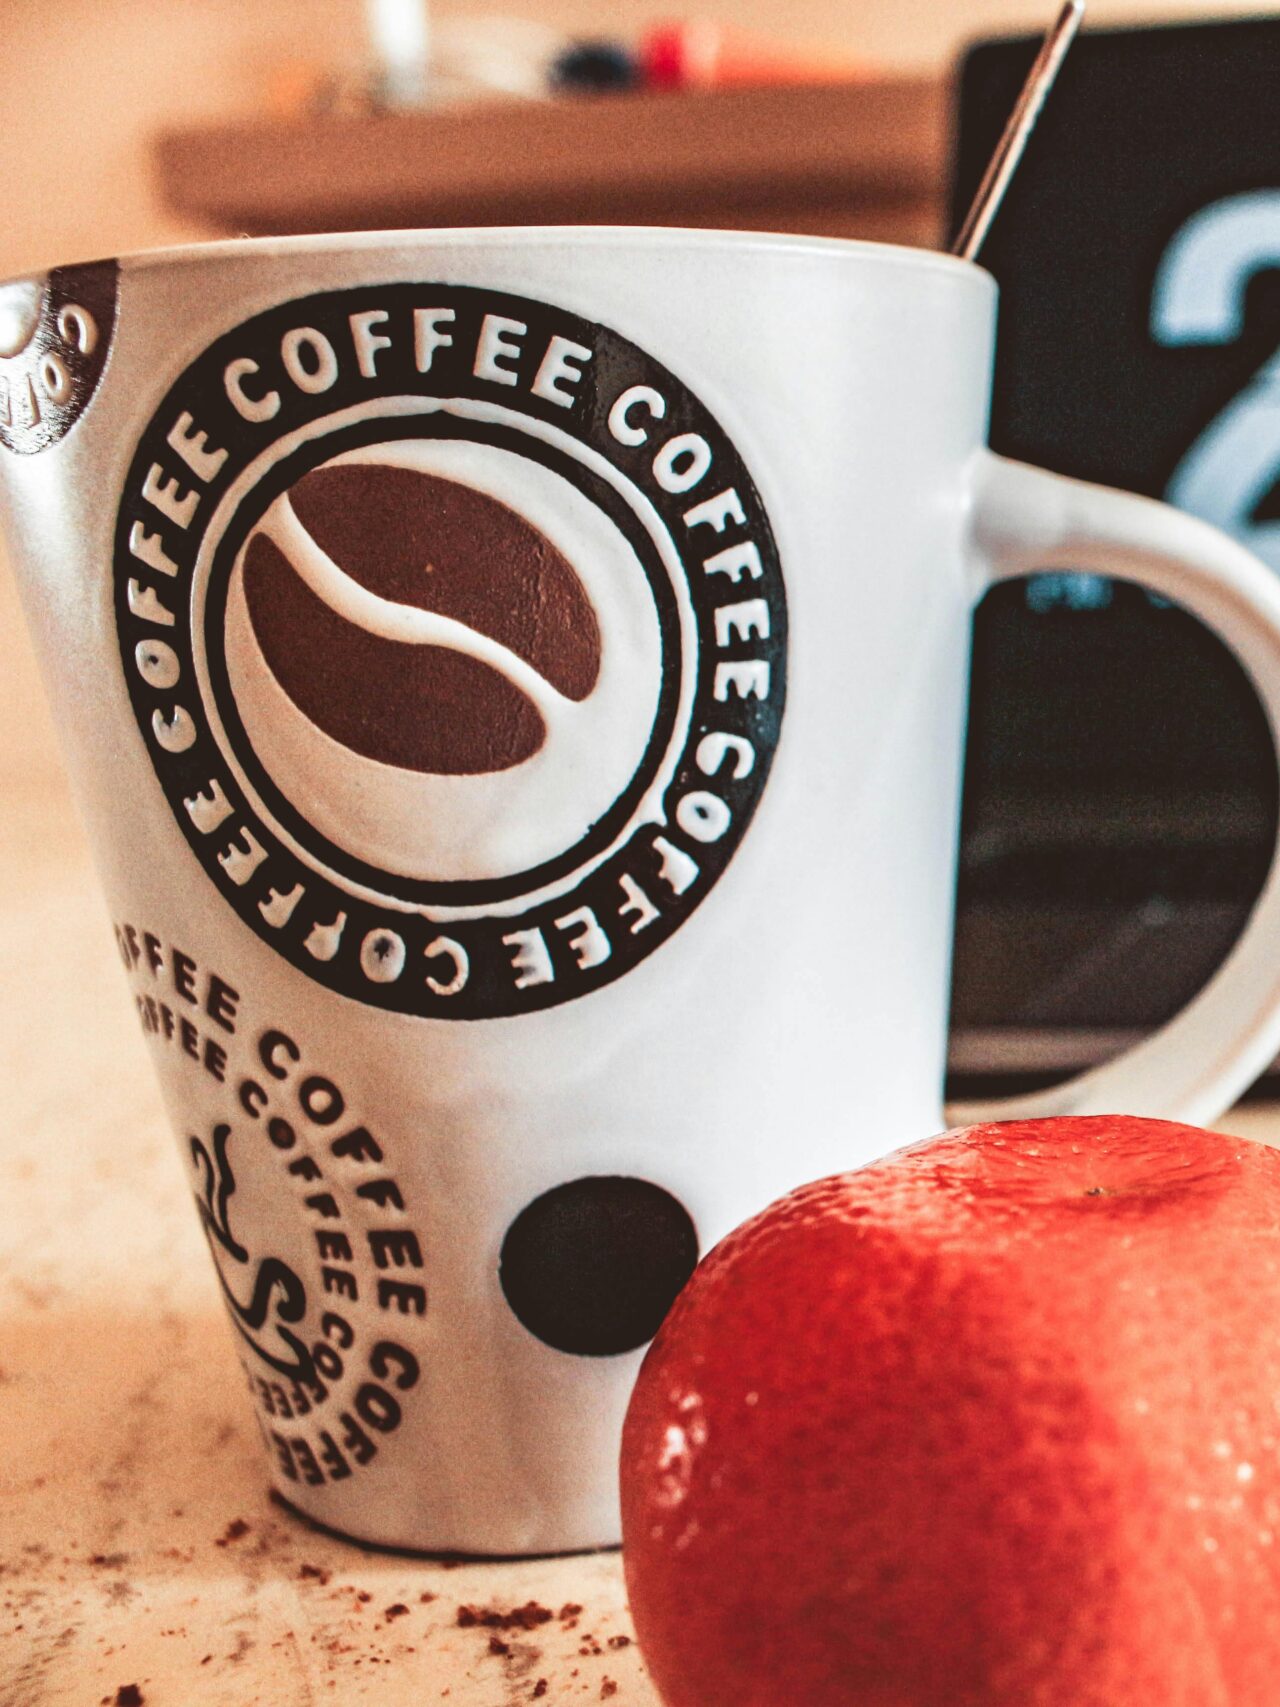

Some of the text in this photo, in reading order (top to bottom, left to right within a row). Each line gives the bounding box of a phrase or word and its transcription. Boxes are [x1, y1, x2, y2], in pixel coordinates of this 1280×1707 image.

[128, 308, 770, 995] COFFEE COFFEE COFFEE COFFEE COFFEE
[239, 1079, 358, 1301] COFFEE
[258, 1029, 427, 1317] COFFEE
[270, 1340, 420, 1486] COFFEE
